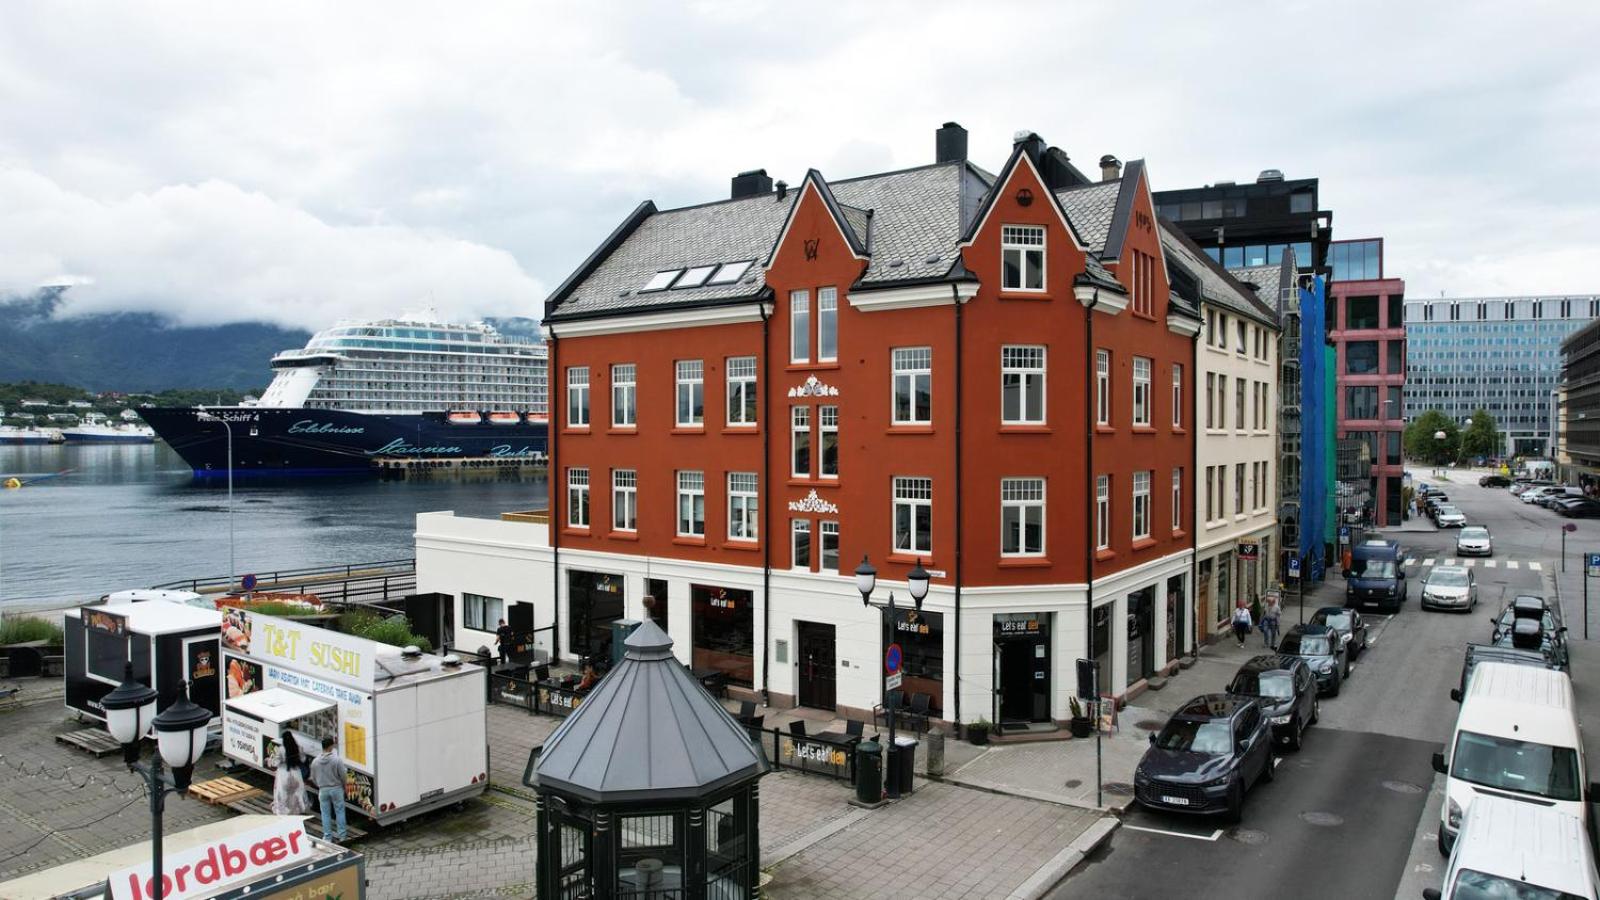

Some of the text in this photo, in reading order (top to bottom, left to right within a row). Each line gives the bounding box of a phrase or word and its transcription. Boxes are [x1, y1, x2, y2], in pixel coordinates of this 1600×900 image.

[223, 413, 252, 422] Schiff
[490, 444, 529, 457] Ruh
[263, 623, 360, 678] T&T SUSHI
[797, 741, 816, 761] Let's
